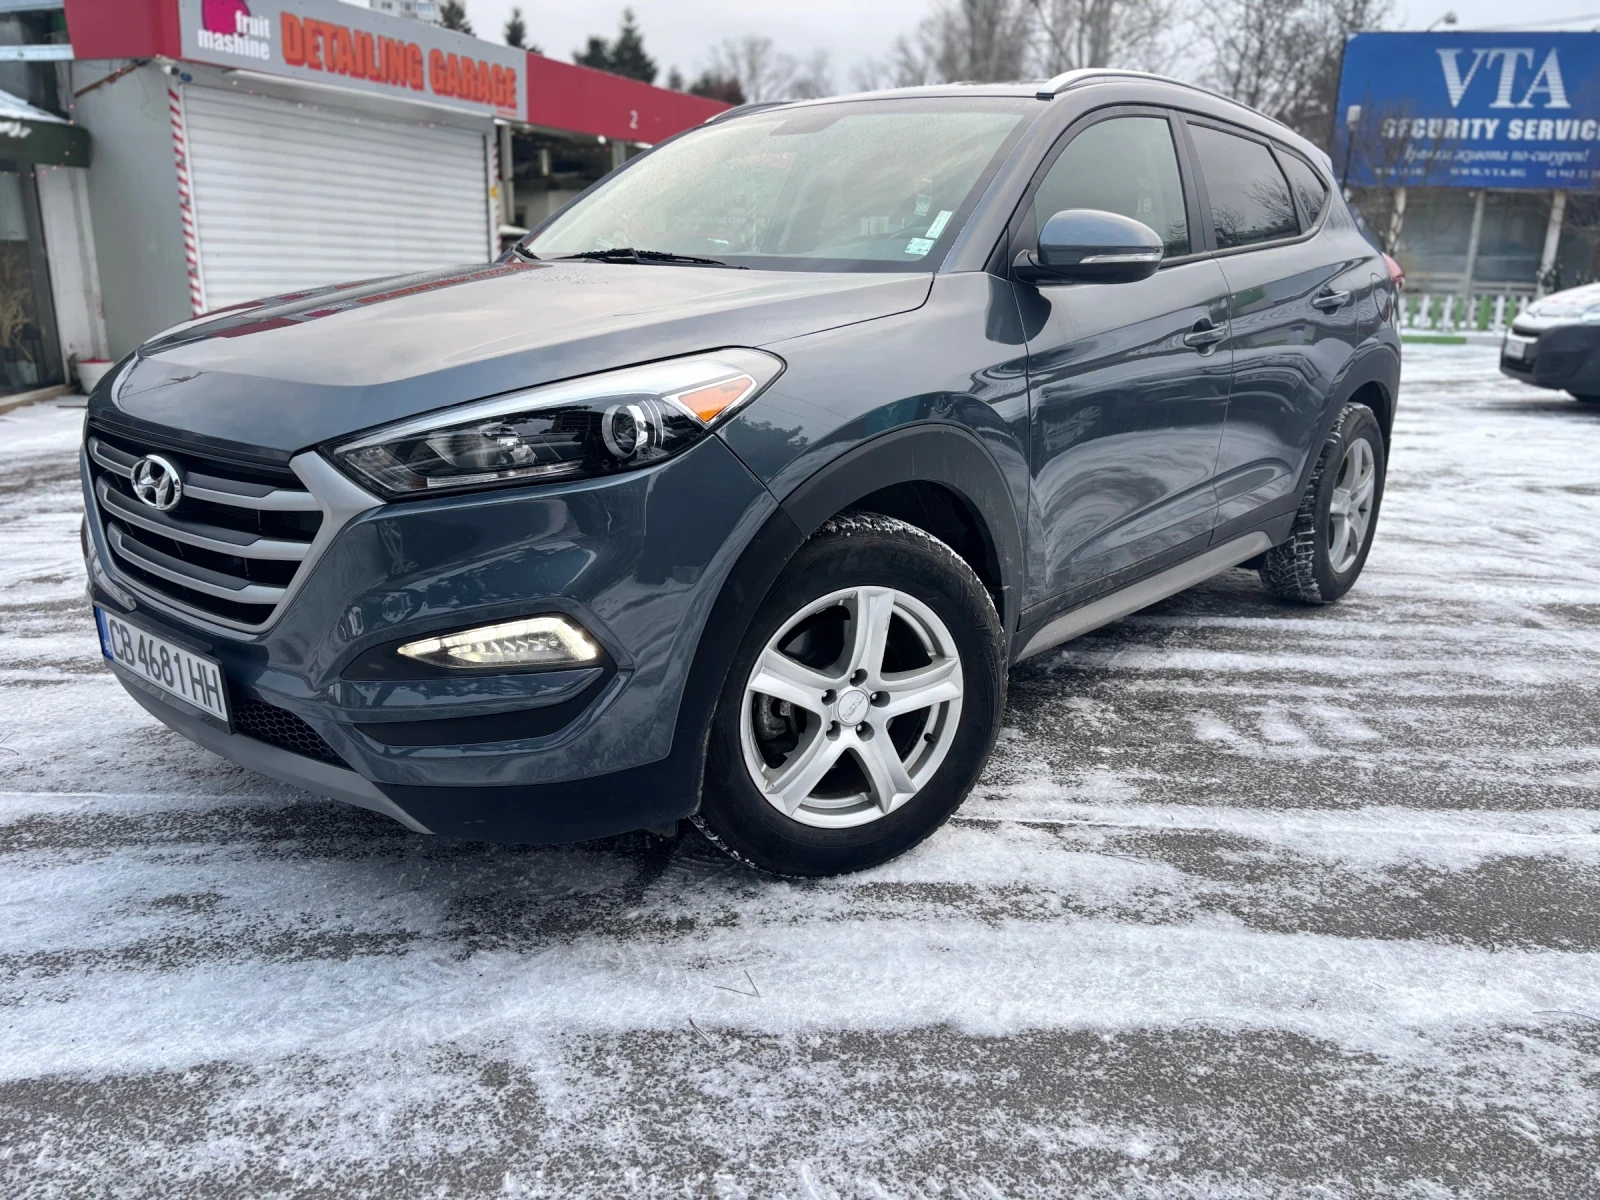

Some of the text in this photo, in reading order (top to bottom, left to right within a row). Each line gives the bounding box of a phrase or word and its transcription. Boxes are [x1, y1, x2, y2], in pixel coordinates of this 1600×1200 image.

[235, 10, 270, 39] fruit
[198, 29, 270, 60] mashine
[280, 11, 517, 109] DETAILING GARAGE
[1436, 47, 1571, 109] VTA
[629, 109, 639, 130] 2
[1381, 118, 1600, 141] SECURITY SERVIC
[109, 619, 223, 713] CB 4681 HH
